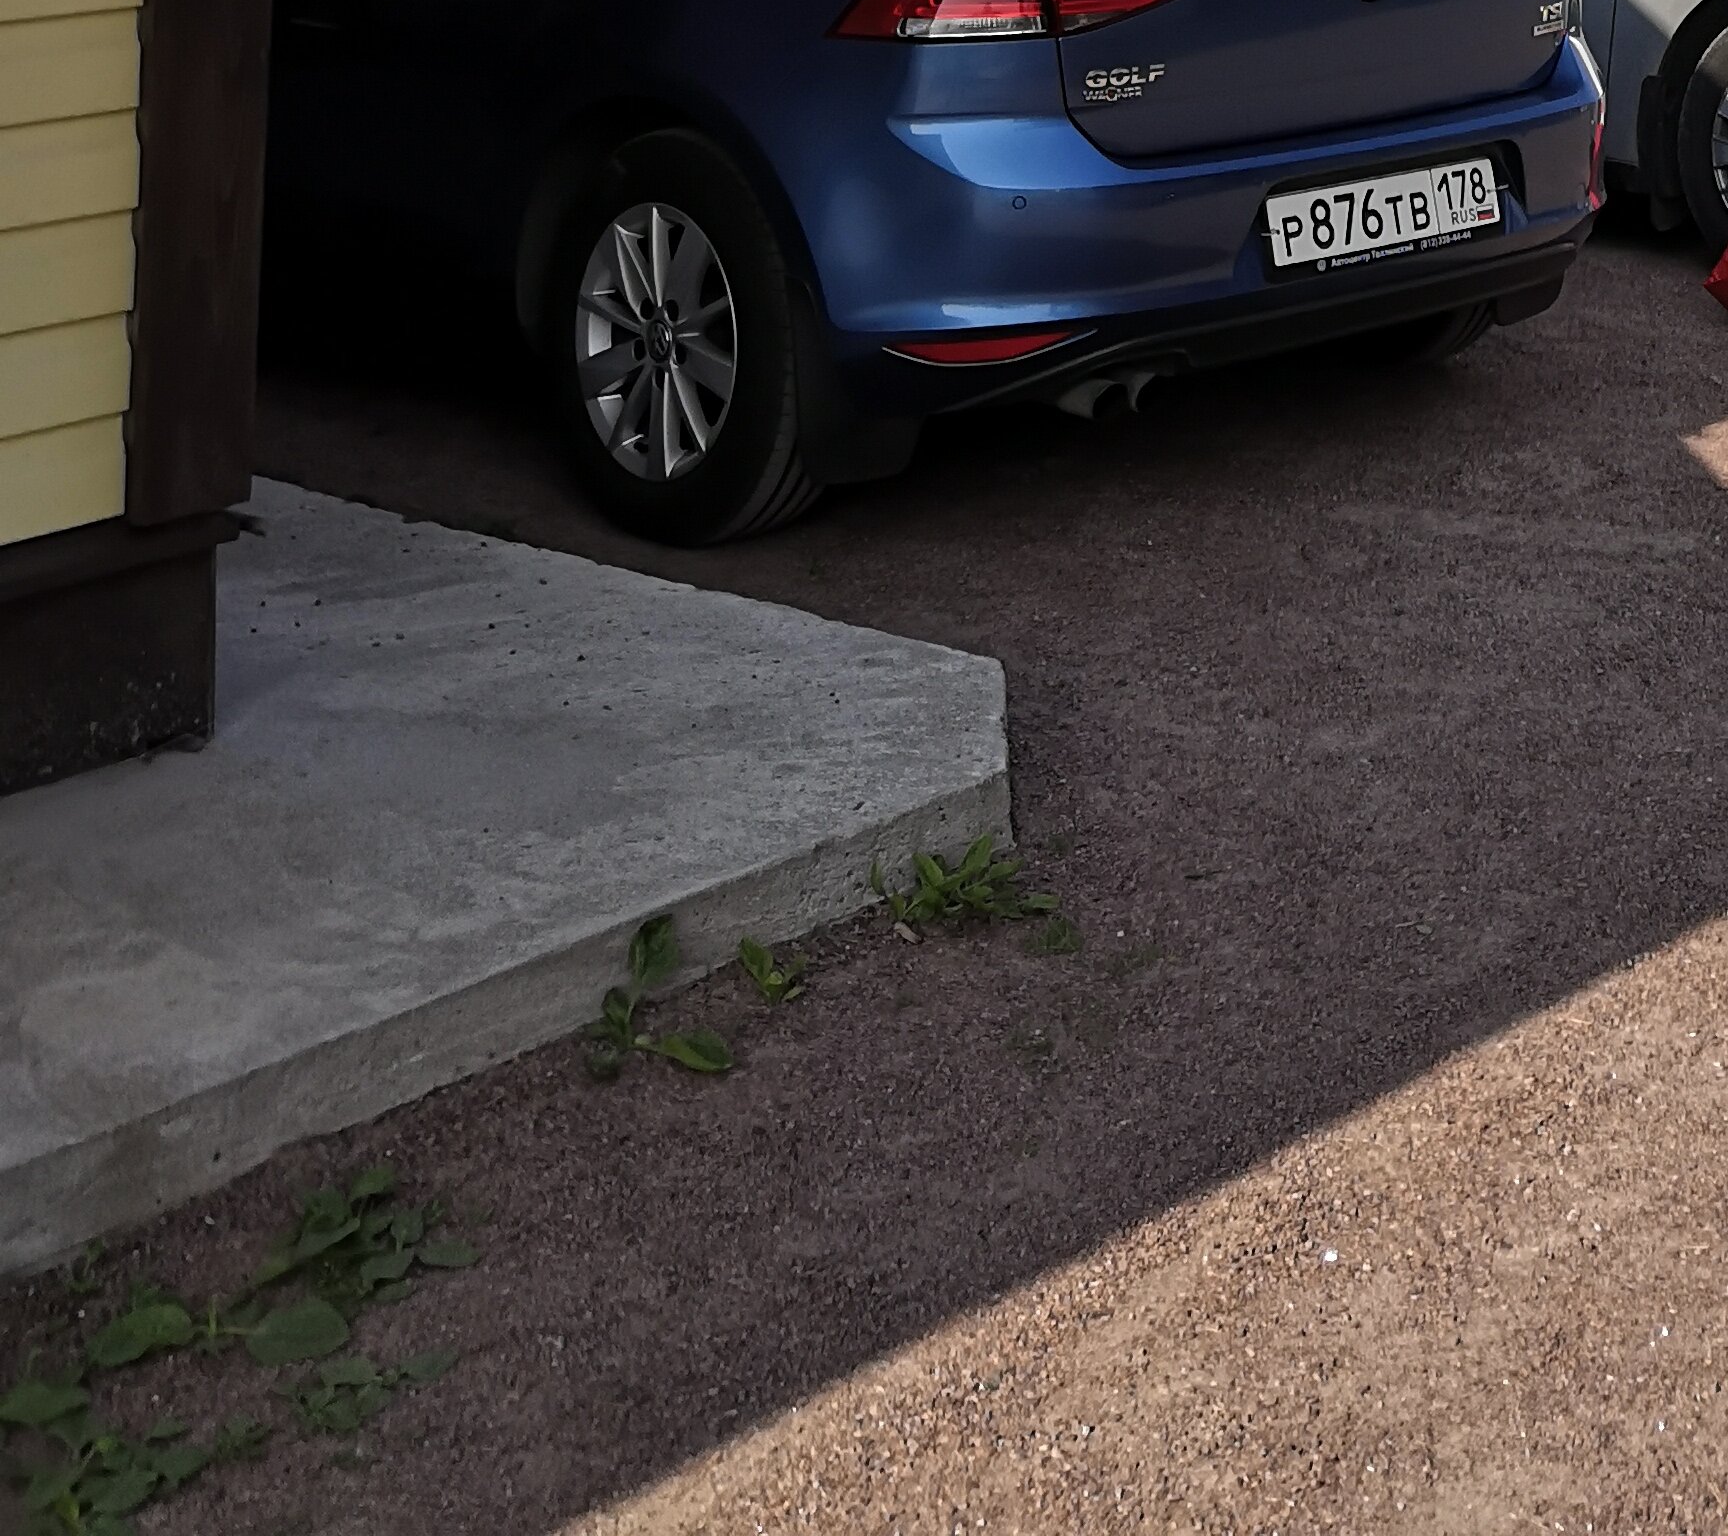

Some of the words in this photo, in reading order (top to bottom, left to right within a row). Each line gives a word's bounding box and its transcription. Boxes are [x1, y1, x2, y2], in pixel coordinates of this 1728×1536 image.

[1085, 63, 1165, 88] GOLF
[1437, 167, 1487, 210] 178
[1451, 207, 1477, 225] RUS
